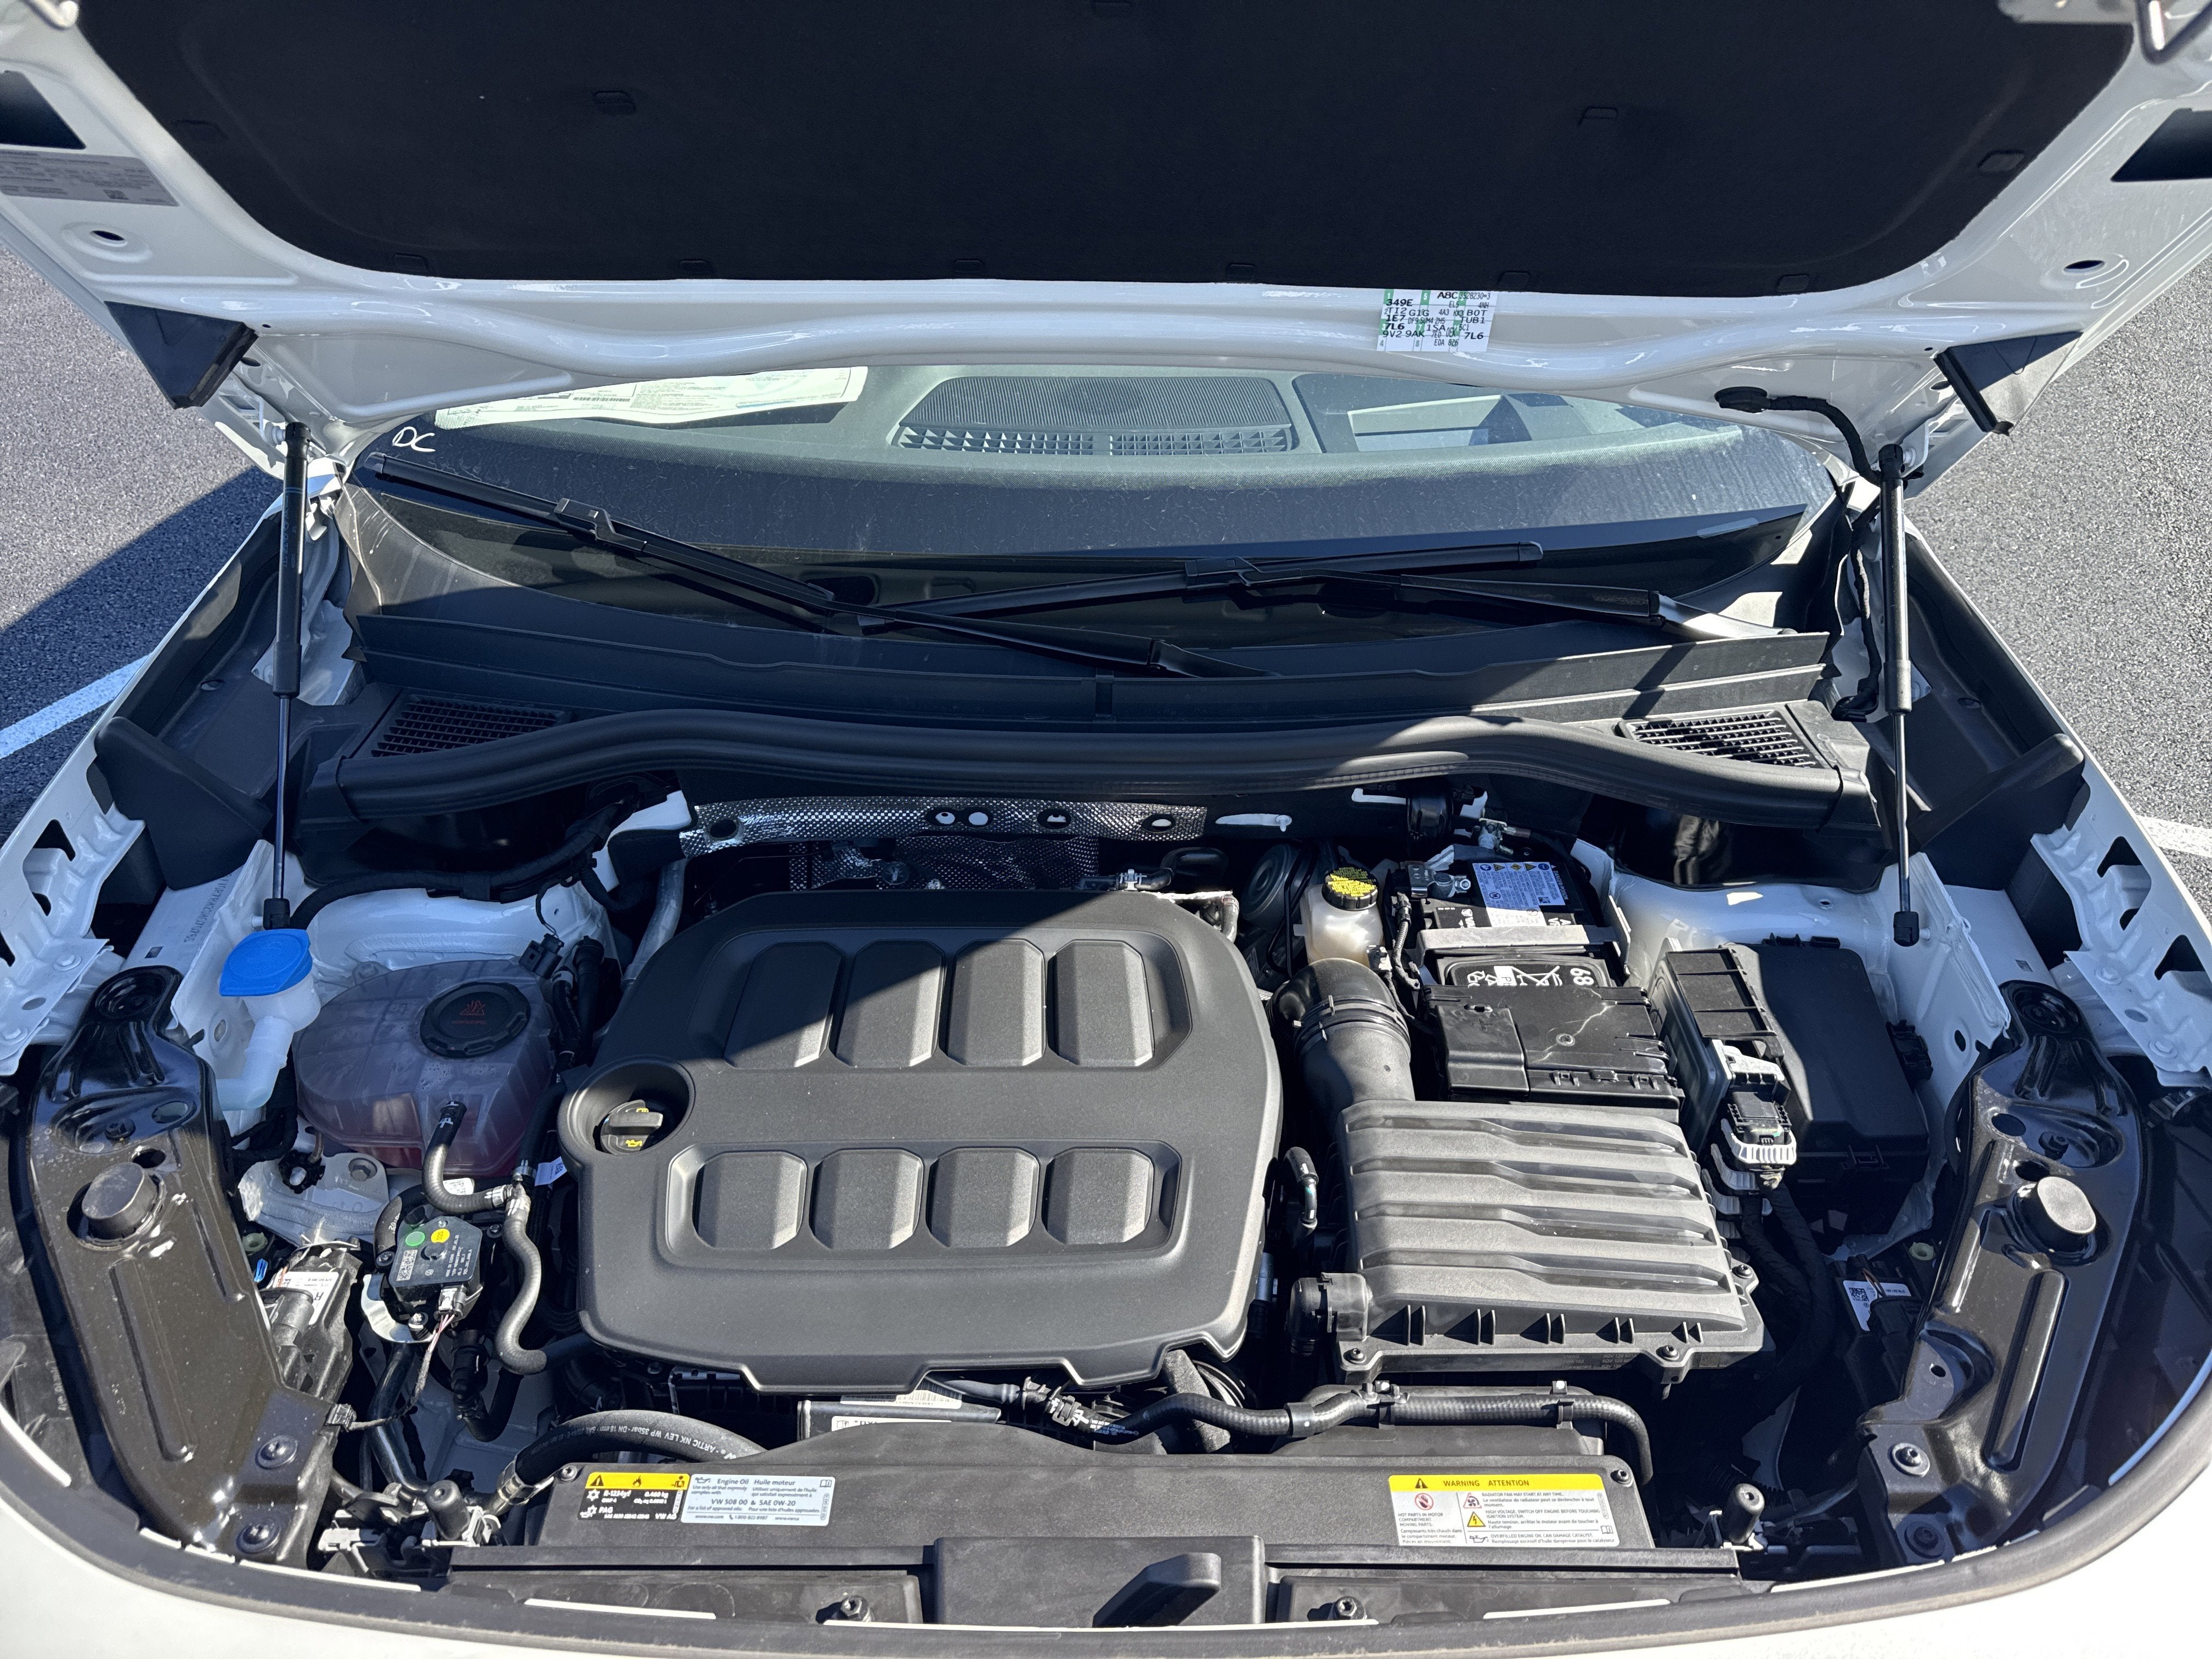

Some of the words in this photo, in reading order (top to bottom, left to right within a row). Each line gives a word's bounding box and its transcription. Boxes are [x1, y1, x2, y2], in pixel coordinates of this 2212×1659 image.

[650, 1430, 662, 1438] WP
[664, 1432, 679, 1442] LEV
[679, 1436, 691, 1445] NK
[692, 1439, 716, 1453] ARTIC
[603, 1489, 631, 1498] R-1234yf
